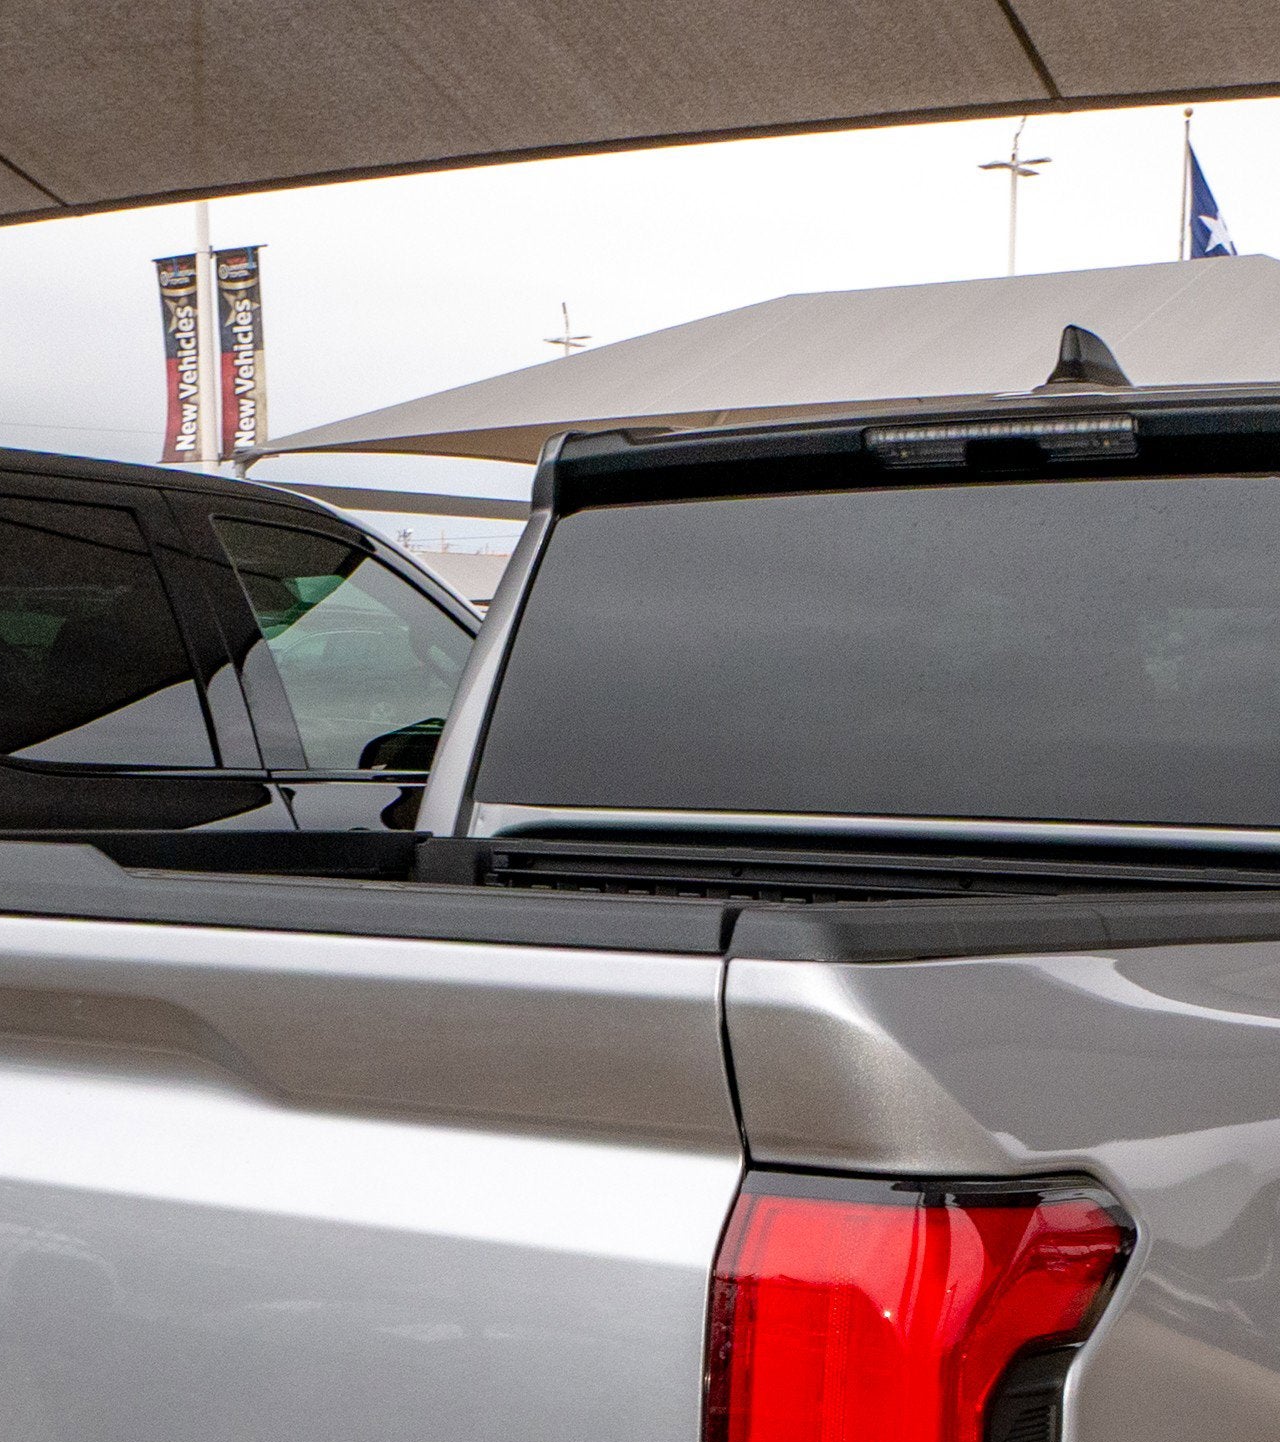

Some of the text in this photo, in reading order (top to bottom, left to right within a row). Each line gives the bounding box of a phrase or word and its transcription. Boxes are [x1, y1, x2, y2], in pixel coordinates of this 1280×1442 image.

[175, 304, 199, 400] Vehicles
[232, 298, 255, 395] Vehicles
[176, 403, 199, 451] New
[234, 399, 256, 448] New
